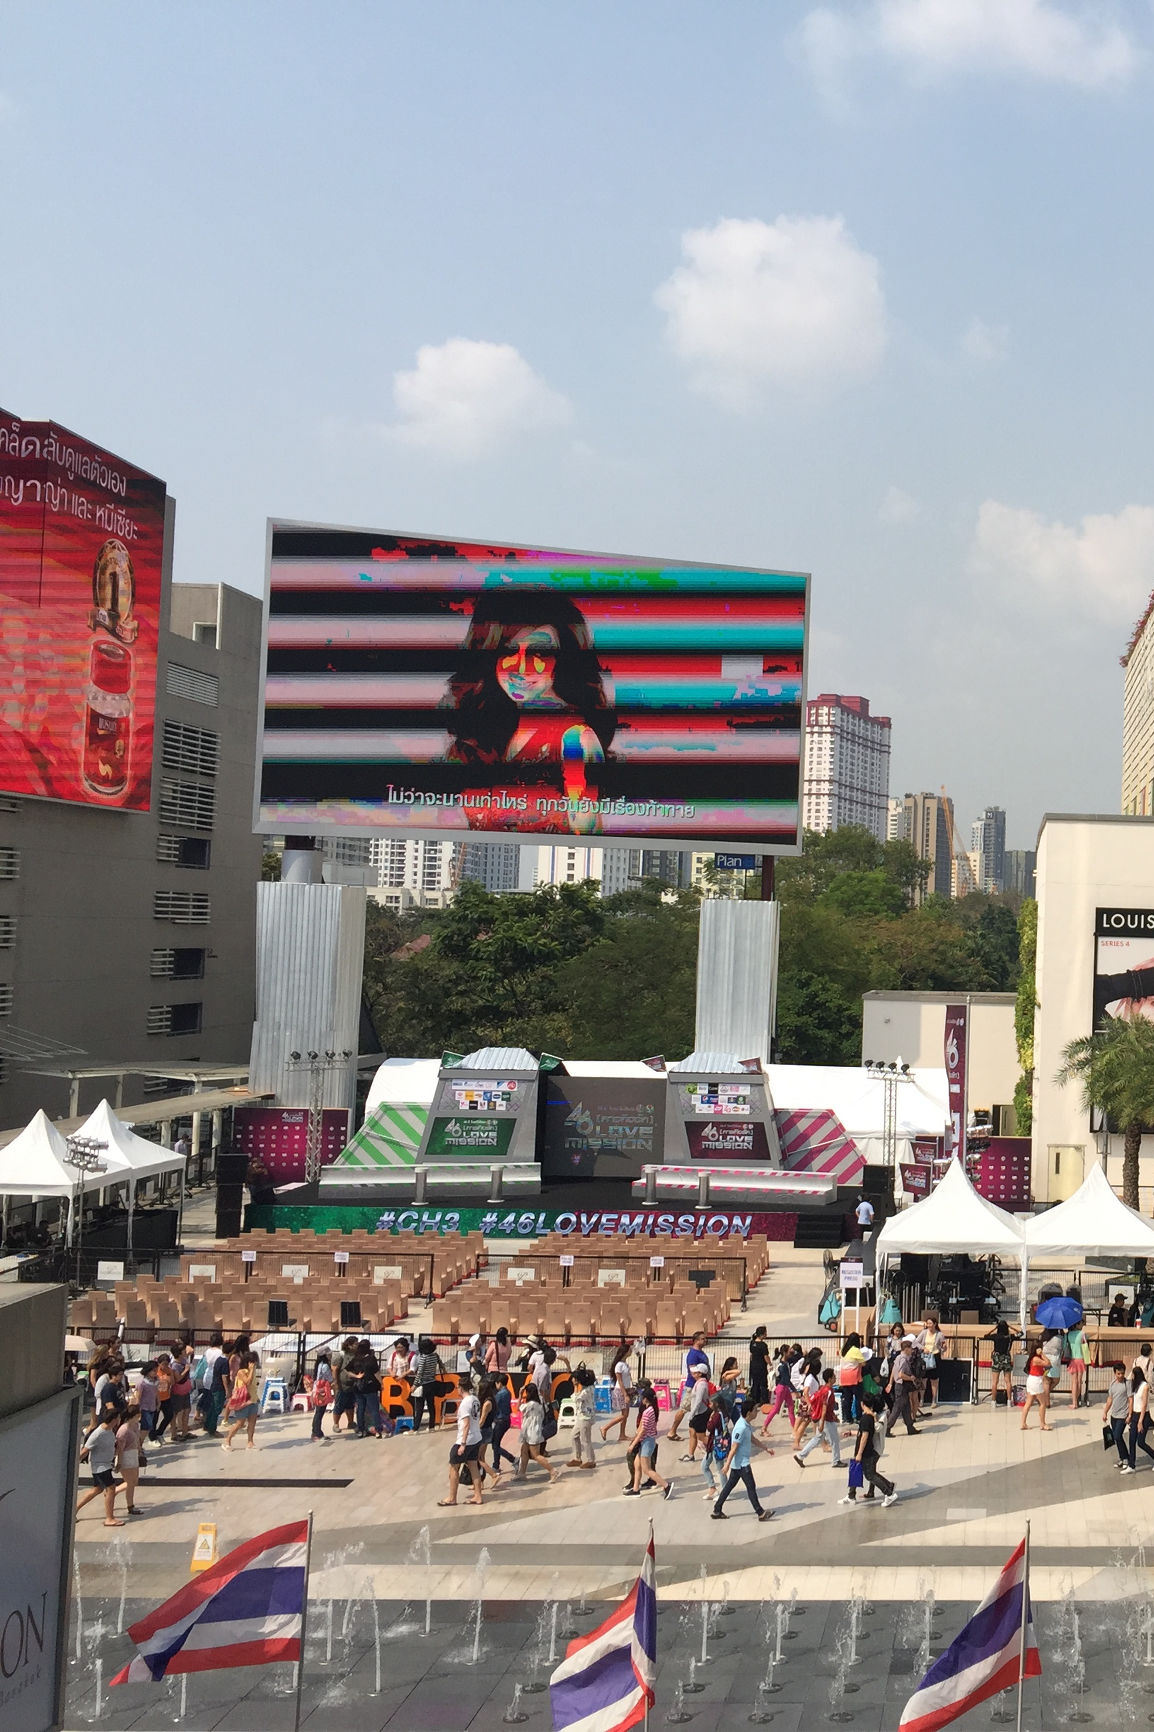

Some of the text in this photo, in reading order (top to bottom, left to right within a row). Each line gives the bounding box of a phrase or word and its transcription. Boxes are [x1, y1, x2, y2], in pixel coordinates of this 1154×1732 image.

[717, 855, 742, 867] Plan
[376, 1211, 753, 1237] #CH3 #46LOVEMISSION
[1, 1590, 49, 1679] ON
